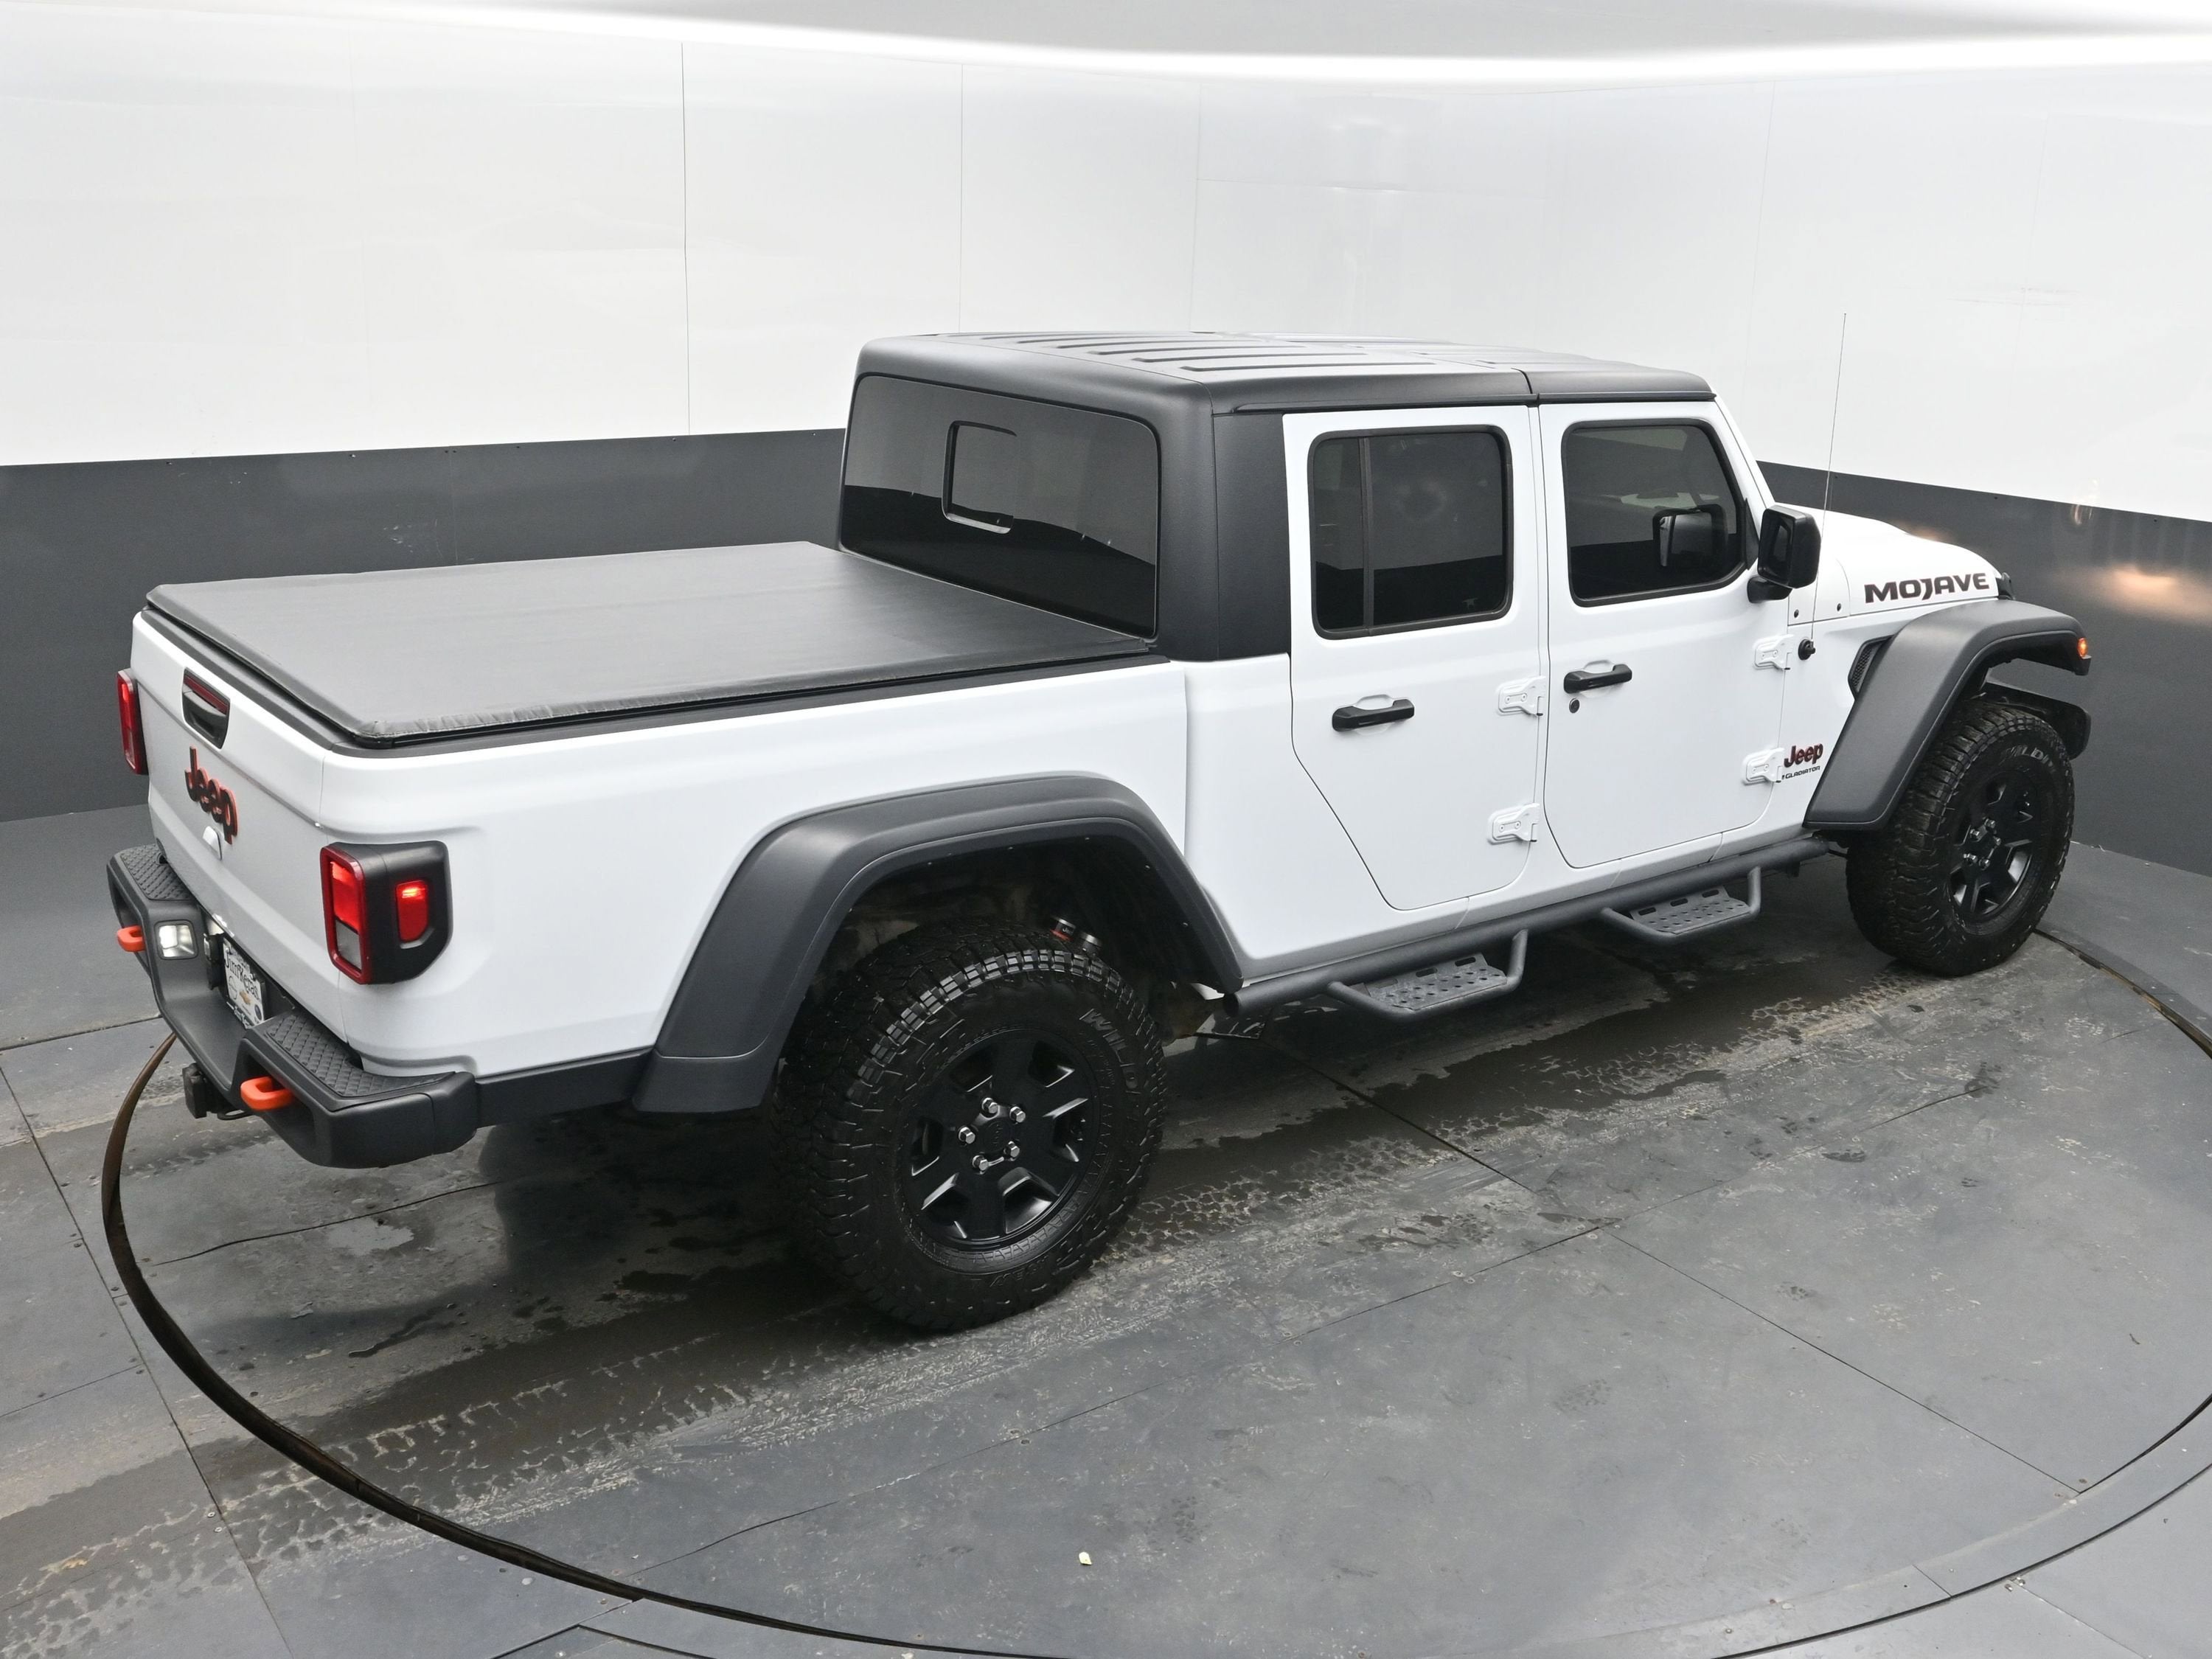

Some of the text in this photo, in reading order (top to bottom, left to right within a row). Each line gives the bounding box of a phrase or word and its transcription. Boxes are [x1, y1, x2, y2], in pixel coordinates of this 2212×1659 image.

[1864, 573, 1989, 603] MOJAVE
[1784, 743, 1823, 768] Jeep
[1785, 765, 1820, 779] GLADIATOR
[184, 745, 238, 845] Jeep
